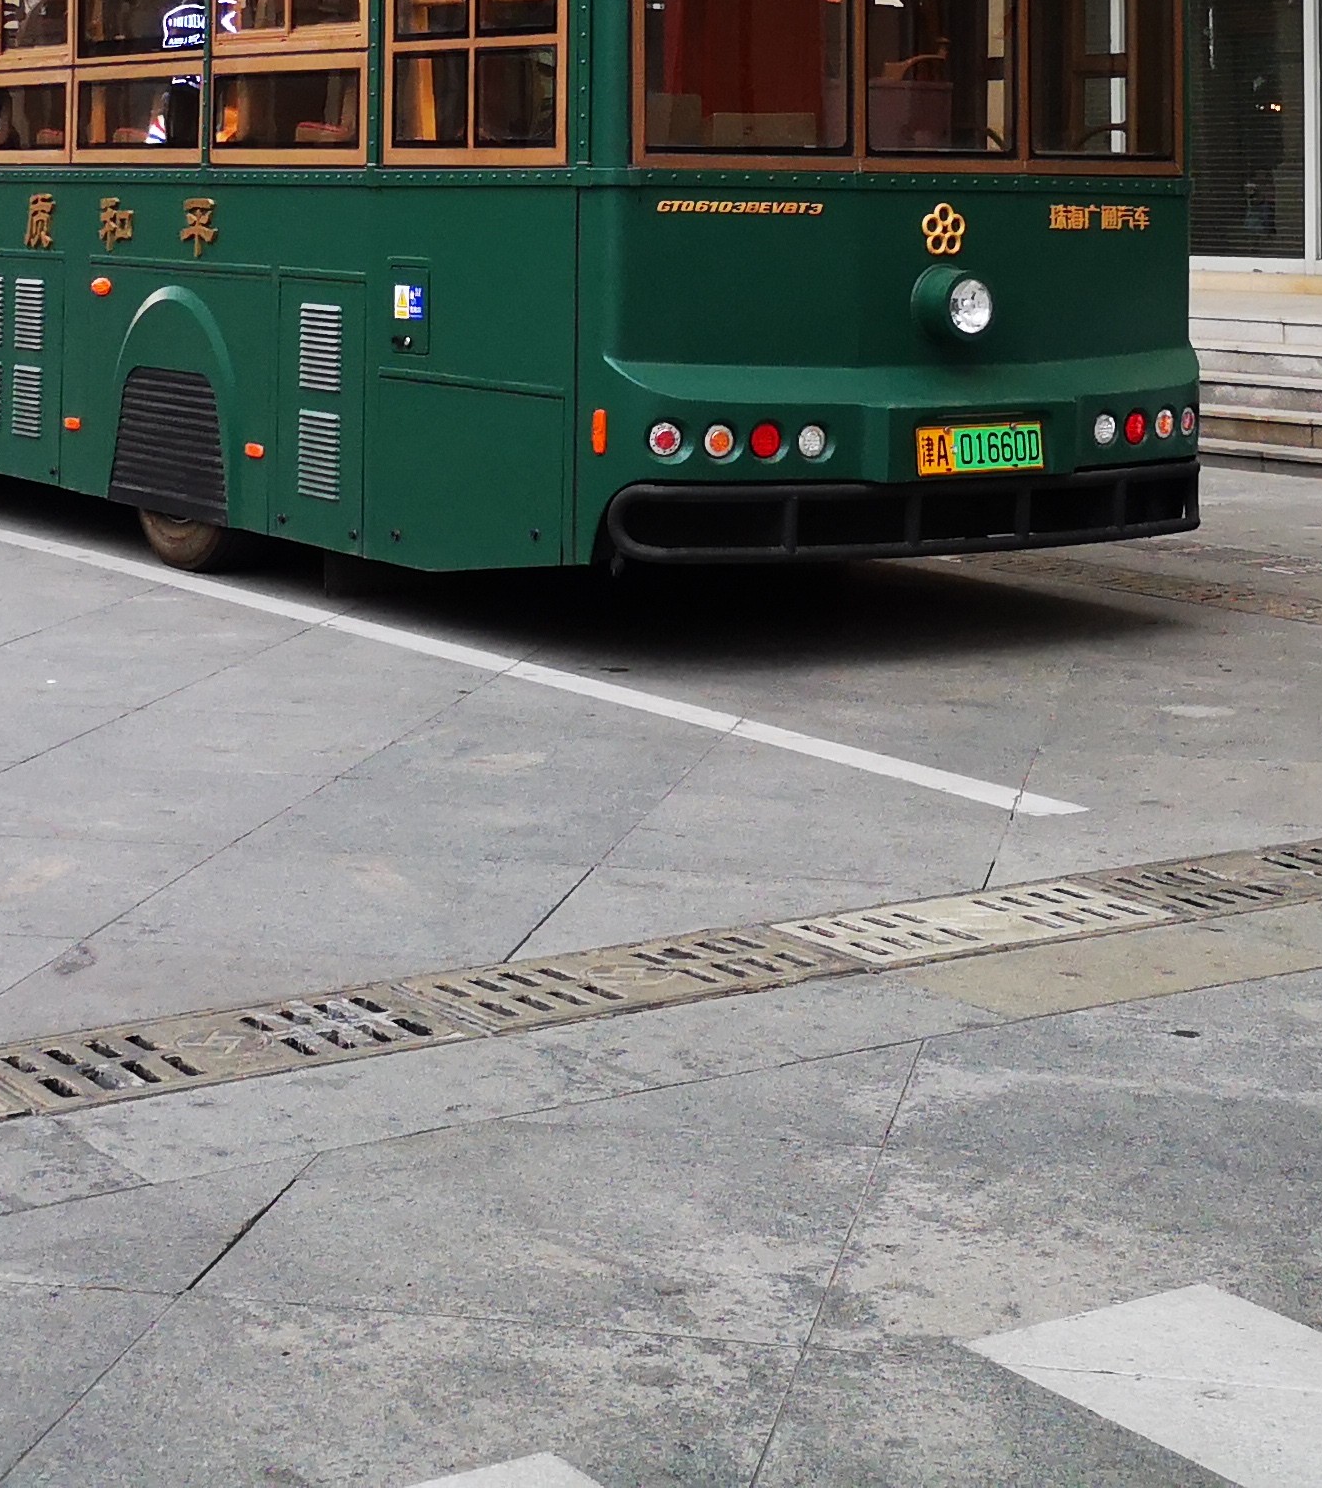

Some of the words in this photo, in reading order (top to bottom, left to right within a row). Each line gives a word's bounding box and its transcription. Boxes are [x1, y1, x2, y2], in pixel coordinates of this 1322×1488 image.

[1049, 204, 1150, 231] 珠海广通汽车
